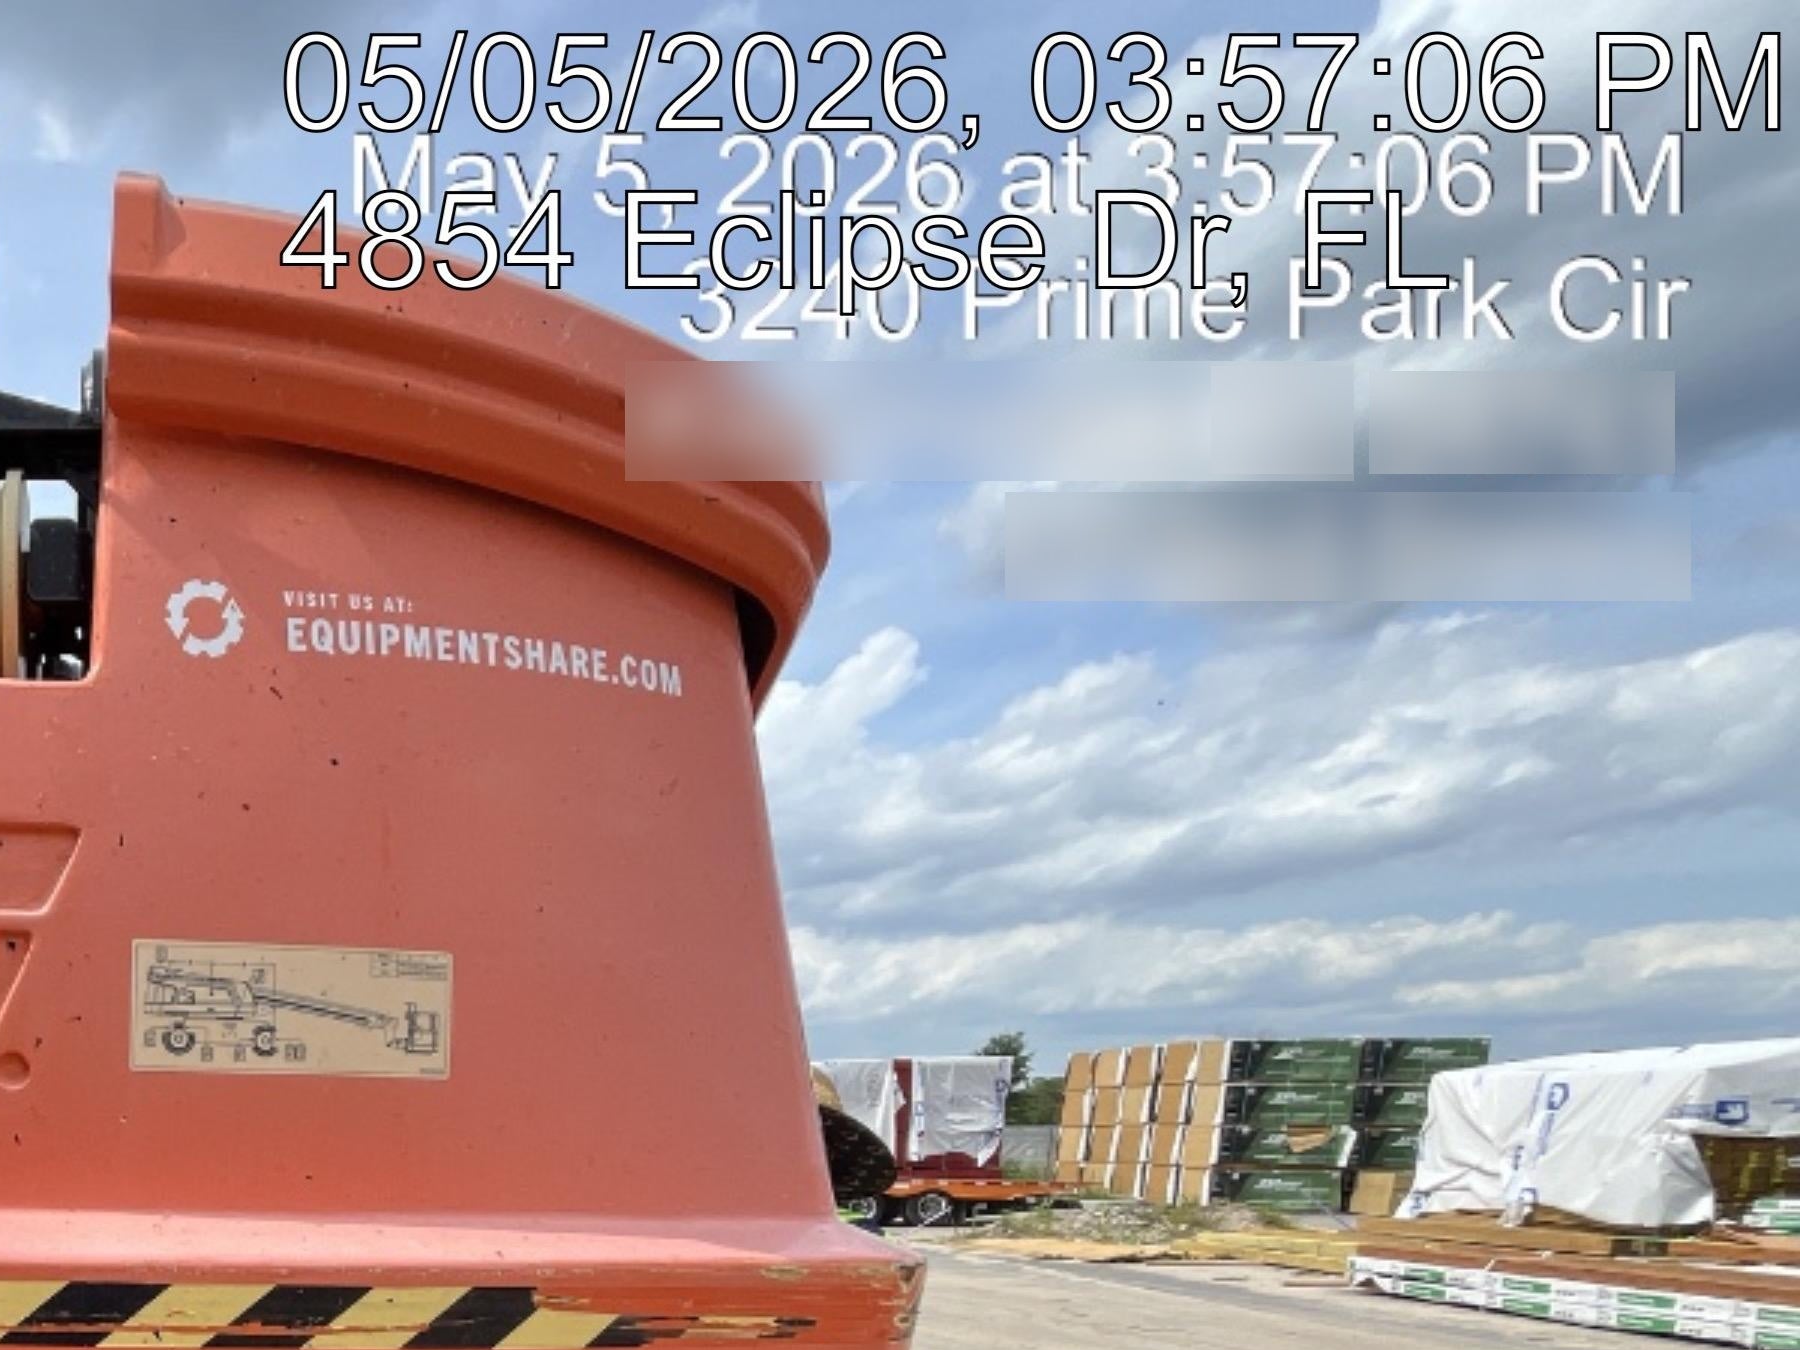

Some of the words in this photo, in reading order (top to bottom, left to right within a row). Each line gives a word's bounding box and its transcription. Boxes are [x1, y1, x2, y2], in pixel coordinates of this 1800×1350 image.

[283, 590, 339, 608] VISIT
[348, 592, 374, 611] US
[383, 595, 415, 614] AT:
[286, 617, 683, 697] EQUIPMENTSHARE.COM
